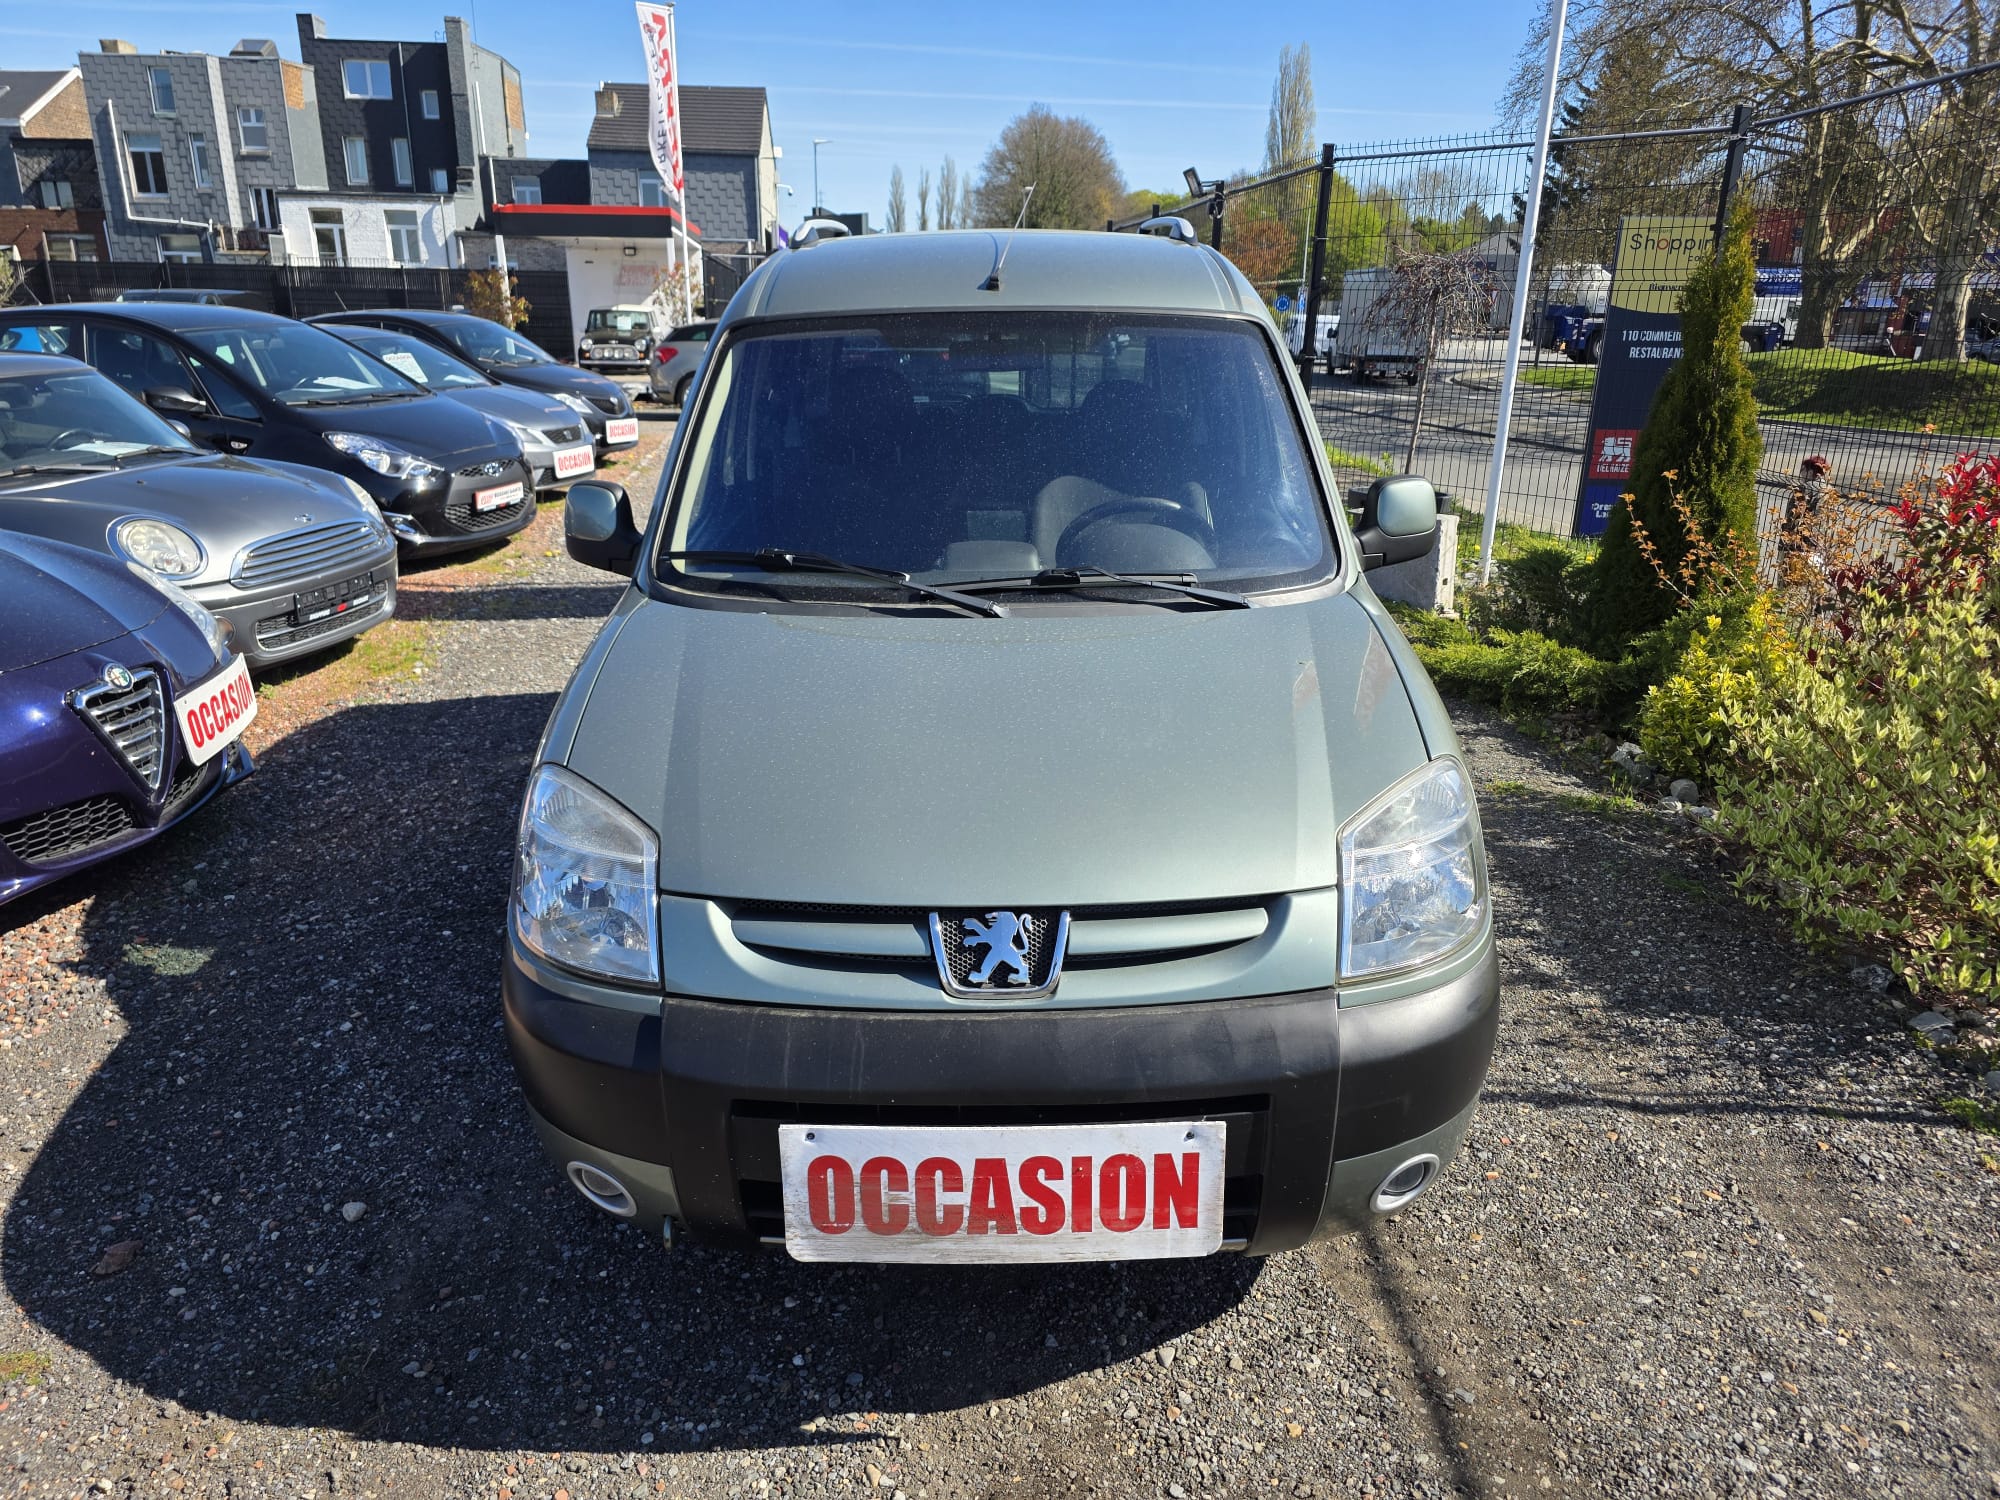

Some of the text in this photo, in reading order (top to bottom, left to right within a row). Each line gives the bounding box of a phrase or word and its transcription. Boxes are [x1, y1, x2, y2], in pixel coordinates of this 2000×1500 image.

[1630, 233, 1714, 254] Shoppin
[609, 423, 636, 437] OCCASION
[558, 451, 591, 472] OCCASION
[187, 670, 253, 748] OCCASION
[807, 1152, 1200, 1236] OCCASION
